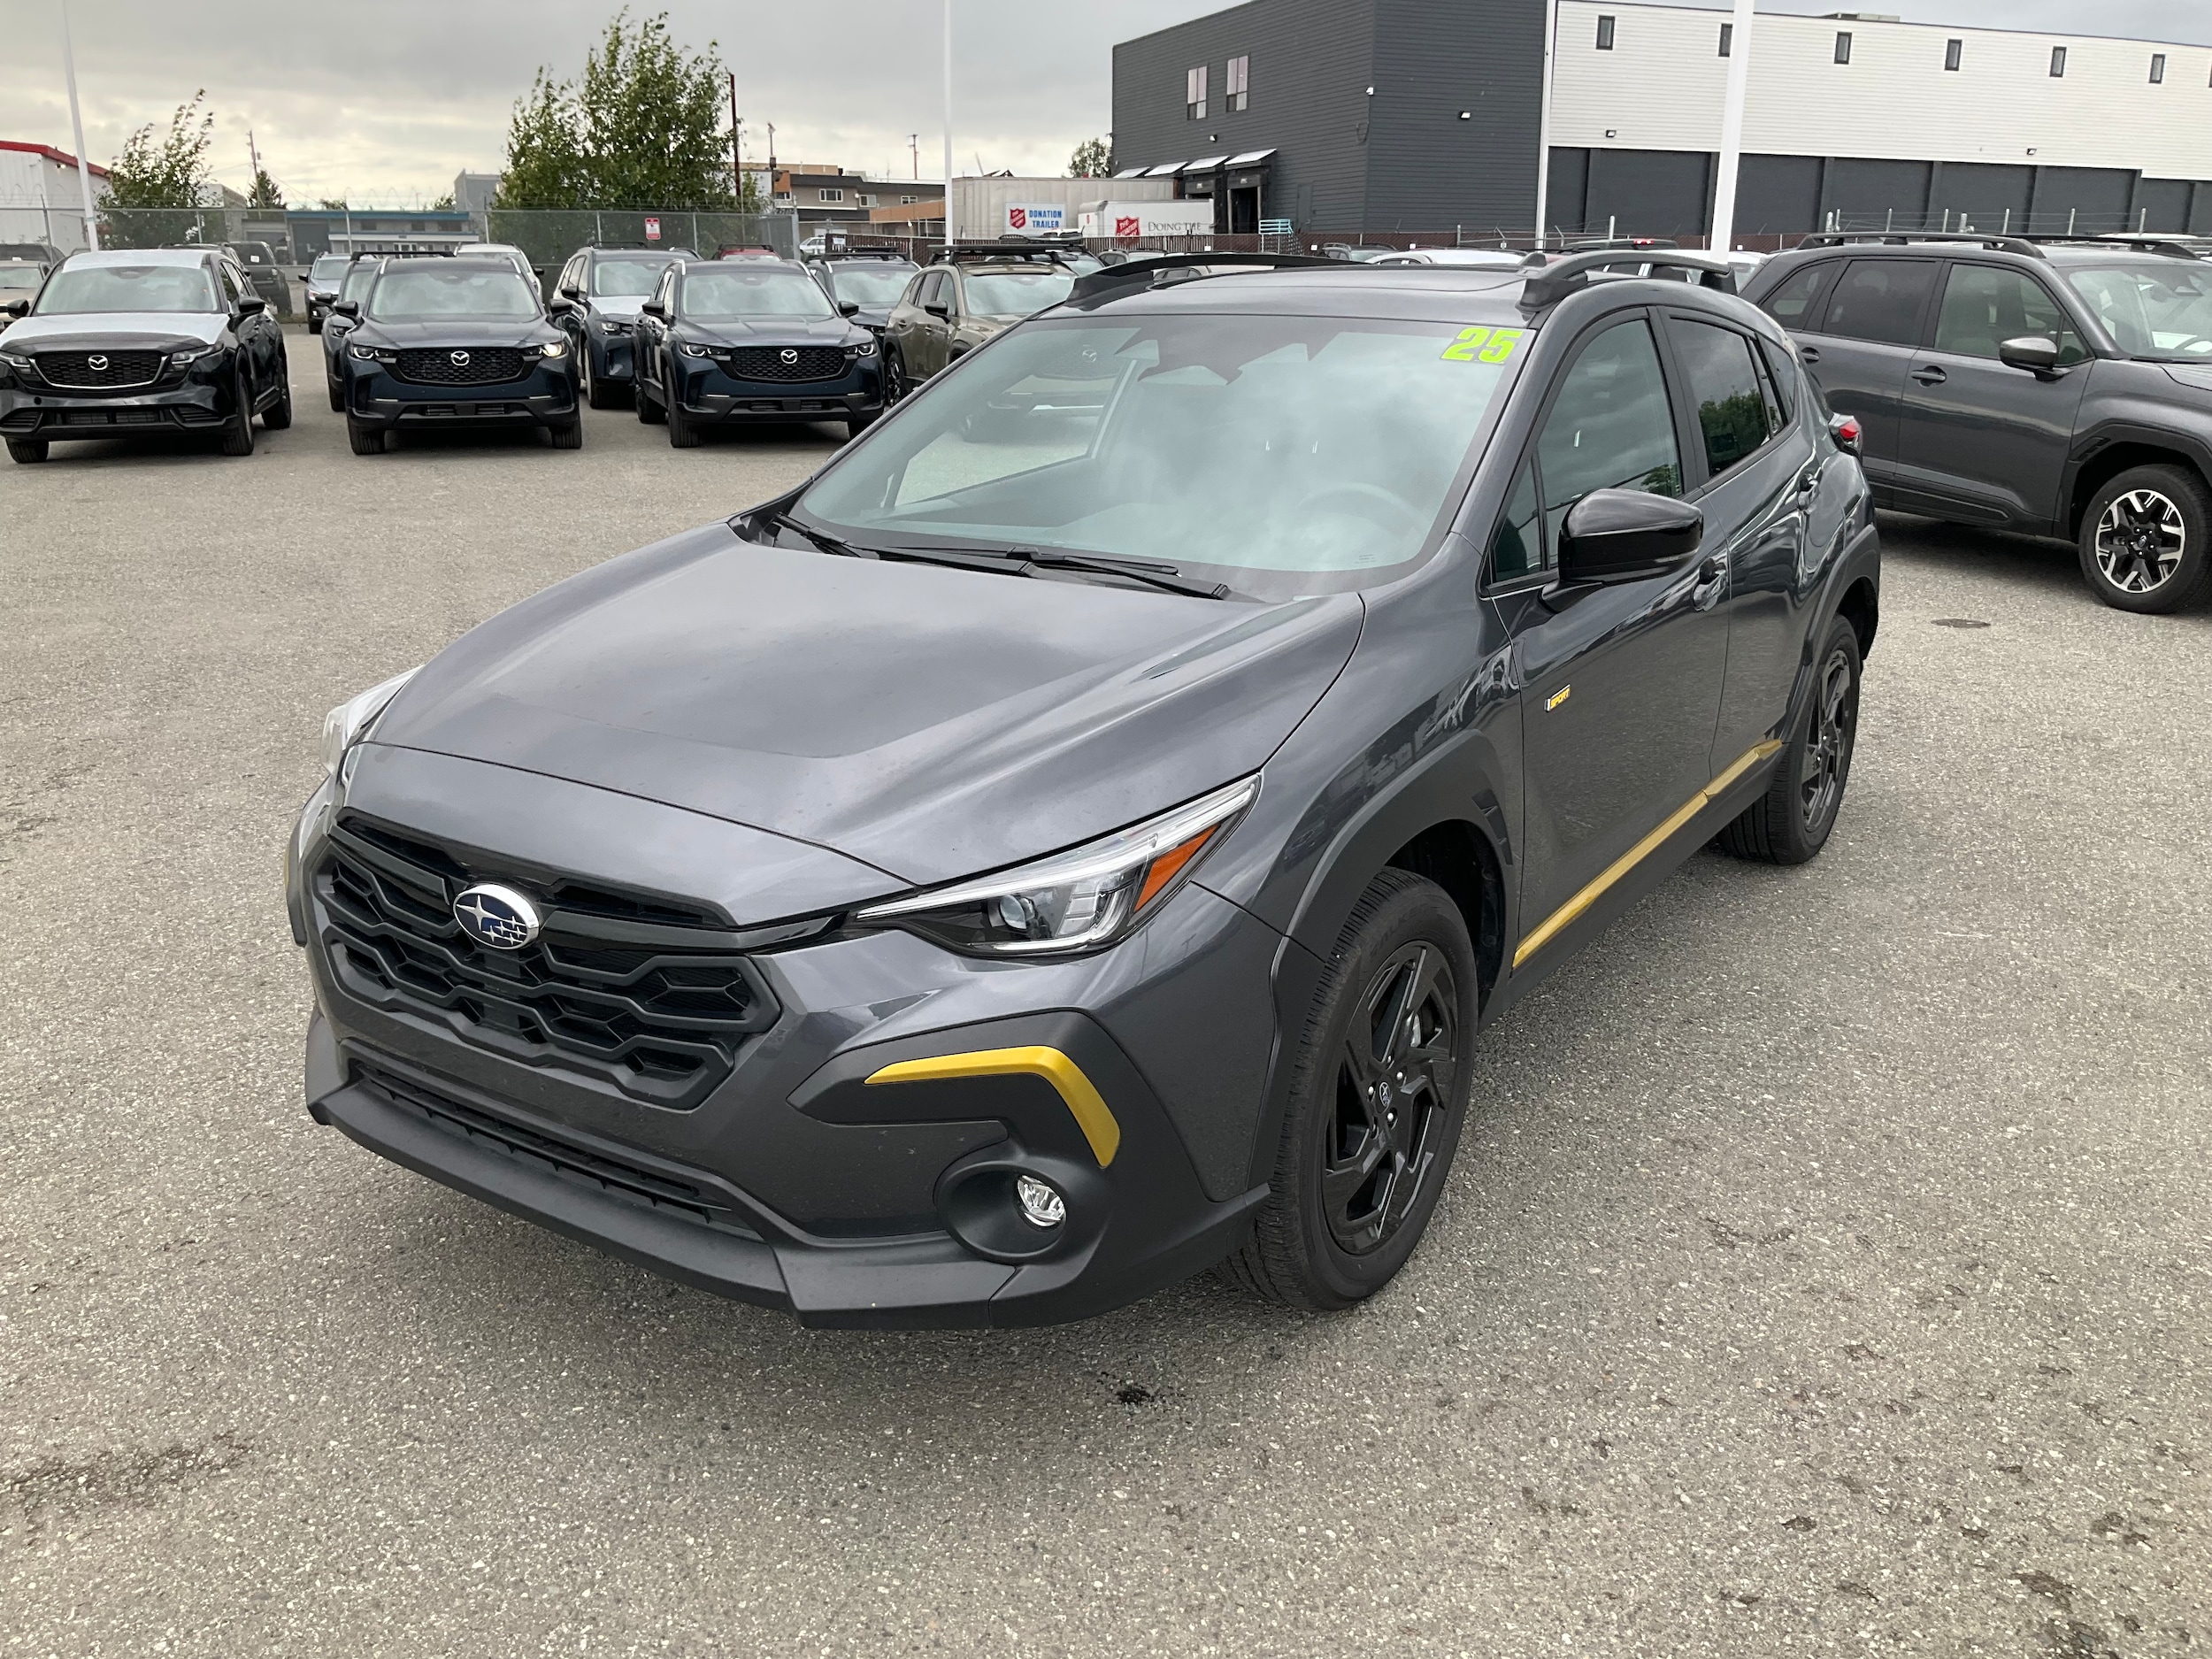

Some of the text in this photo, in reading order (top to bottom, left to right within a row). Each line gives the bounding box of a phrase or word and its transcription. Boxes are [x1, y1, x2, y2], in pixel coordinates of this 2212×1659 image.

[1148, 221, 1202, 231] DOING THE
[1440, 327, 1523, 363] 25
